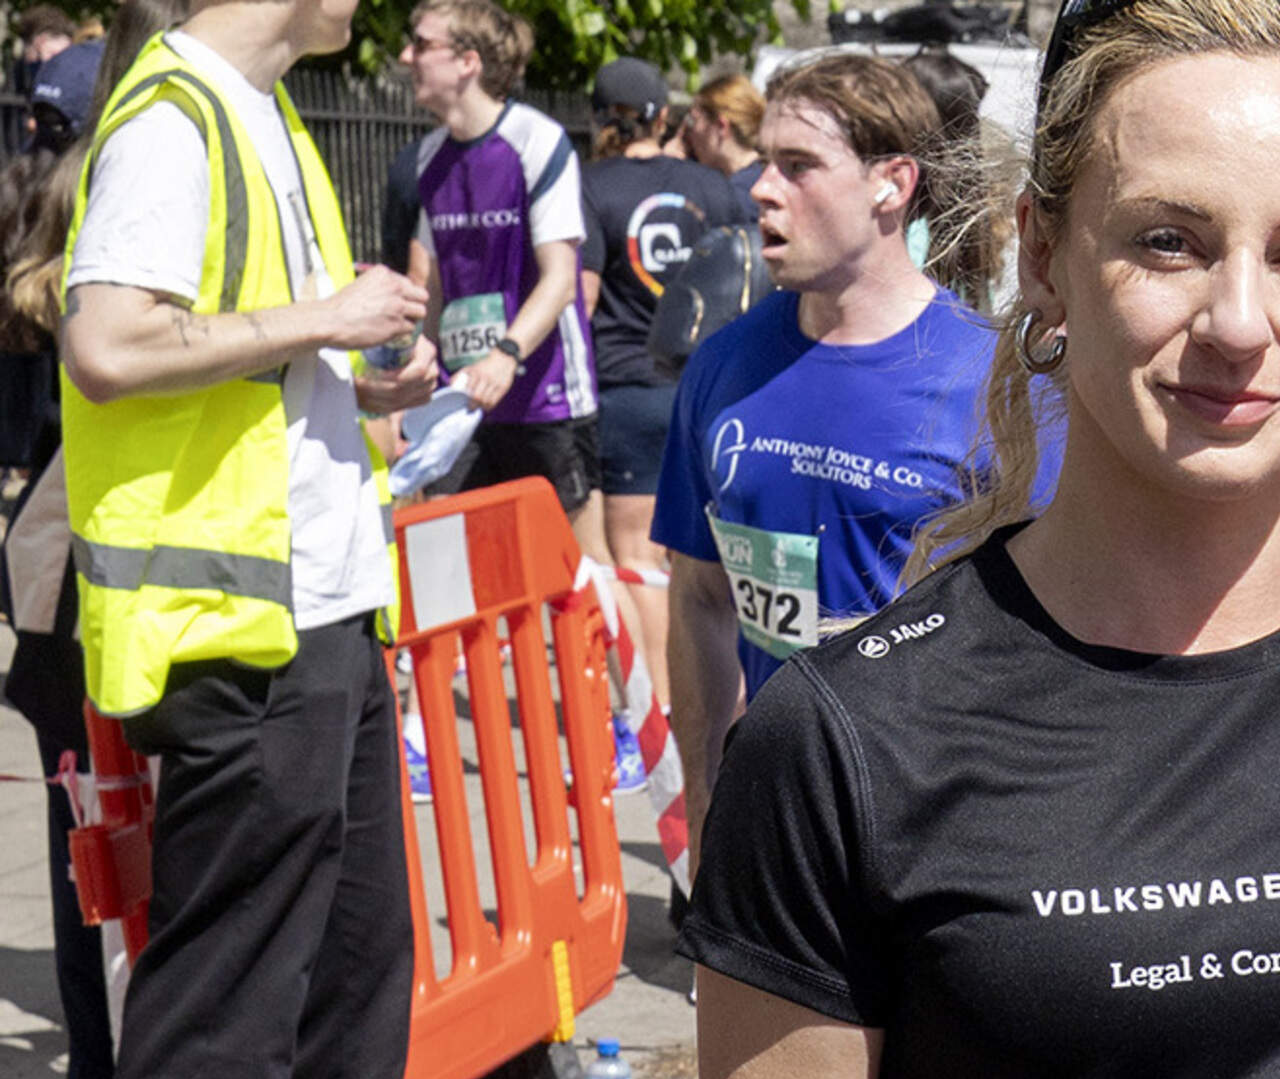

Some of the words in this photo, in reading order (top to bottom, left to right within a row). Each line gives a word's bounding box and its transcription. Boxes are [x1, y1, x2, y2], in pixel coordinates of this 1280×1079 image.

[451, 326, 499, 353] 1256
[751, 436, 826, 460] ANTHONY
[826, 447, 873, 474] JOYCE
[874, 462, 889, 479] &
[791, 457, 872, 490] SOLICITORS
[738, 580, 801, 636] 372
[889, 614, 945, 644] JAKO
[1110, 956, 1193, 989] Legal
[1200, 954, 1224, 979] &
